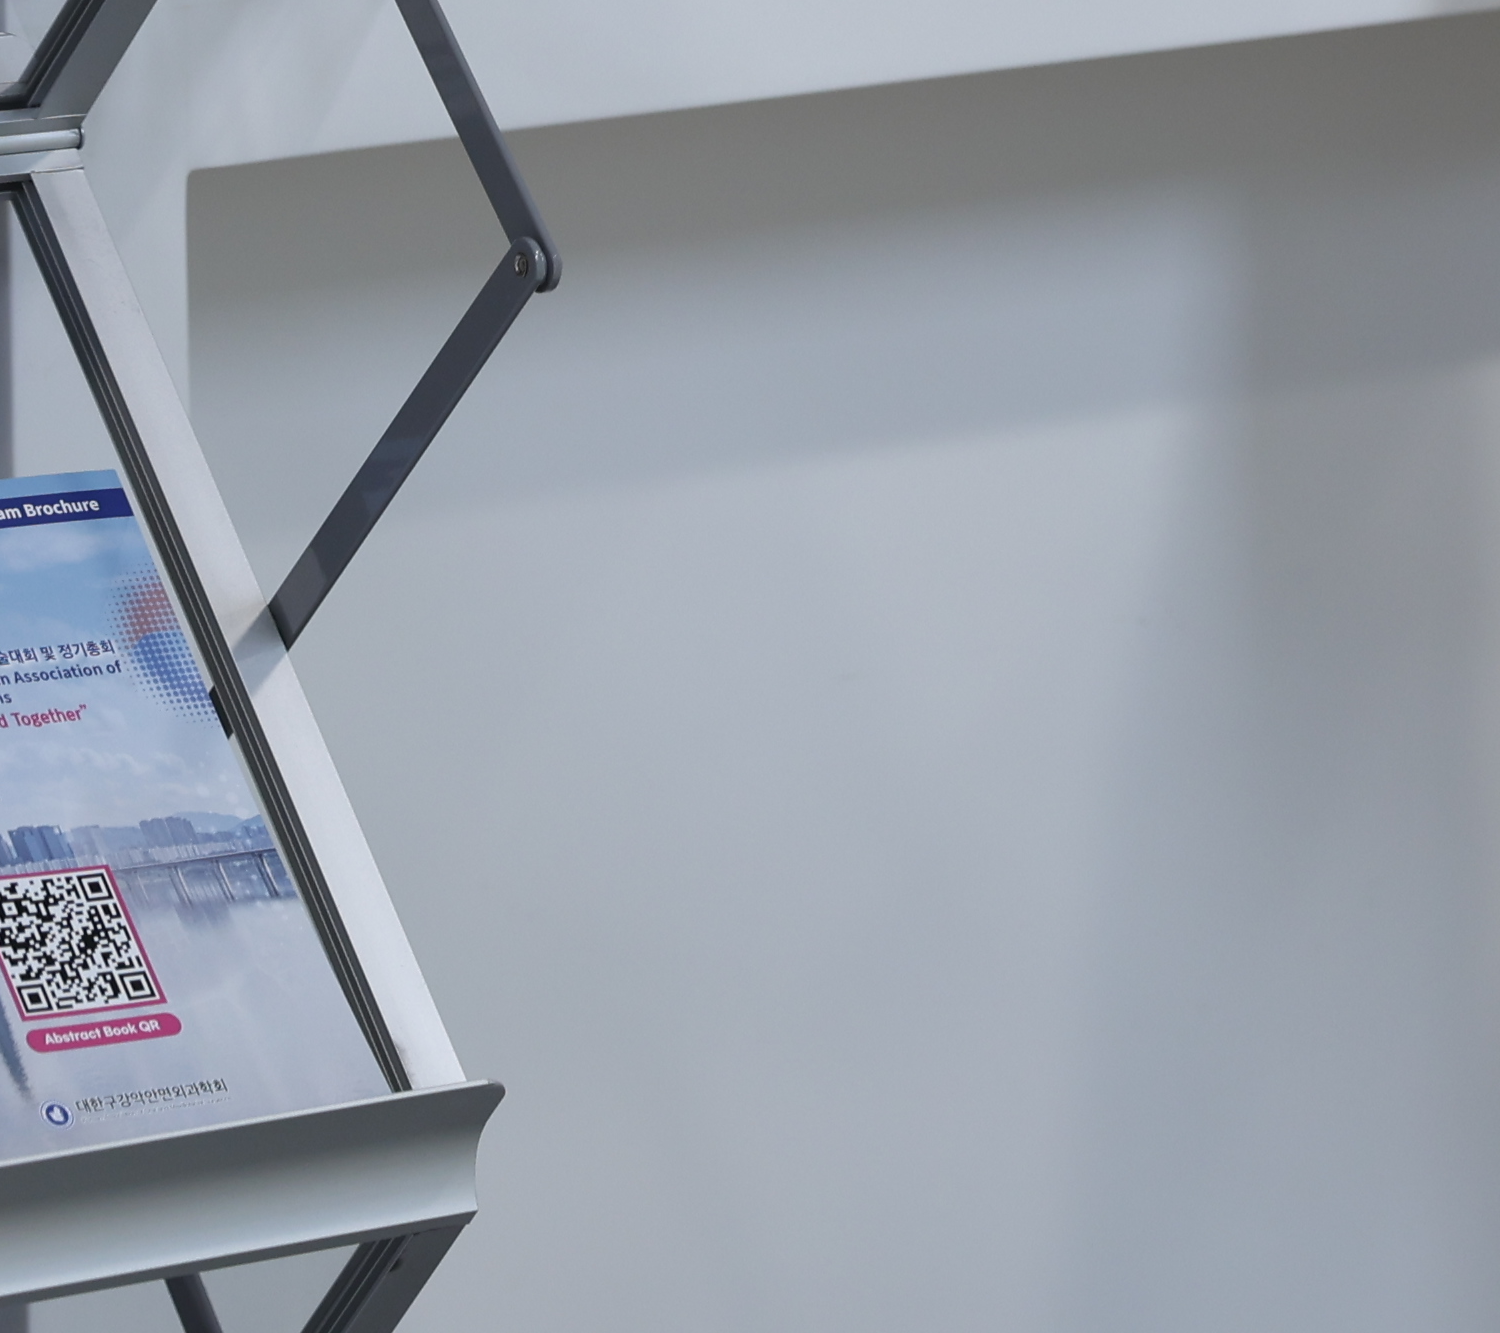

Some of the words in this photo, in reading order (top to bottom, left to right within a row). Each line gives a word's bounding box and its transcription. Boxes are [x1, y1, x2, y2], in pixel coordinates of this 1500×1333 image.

[23, 499, 100, 518] Brochure
[40, 645, 57, 661] 및
[59, 639, 115, 660] 정기총회
[14, 663, 103, 684] Association
[106, 659, 123, 674] of
[11, 704, 87, 728] Together”
[44, 1028, 102, 1045] Abstract
[103, 1024, 137, 1039] Book
[139, 1019, 161, 1033] QR
[75, 1078, 228, 1113] 대한구강악안면외과학회
